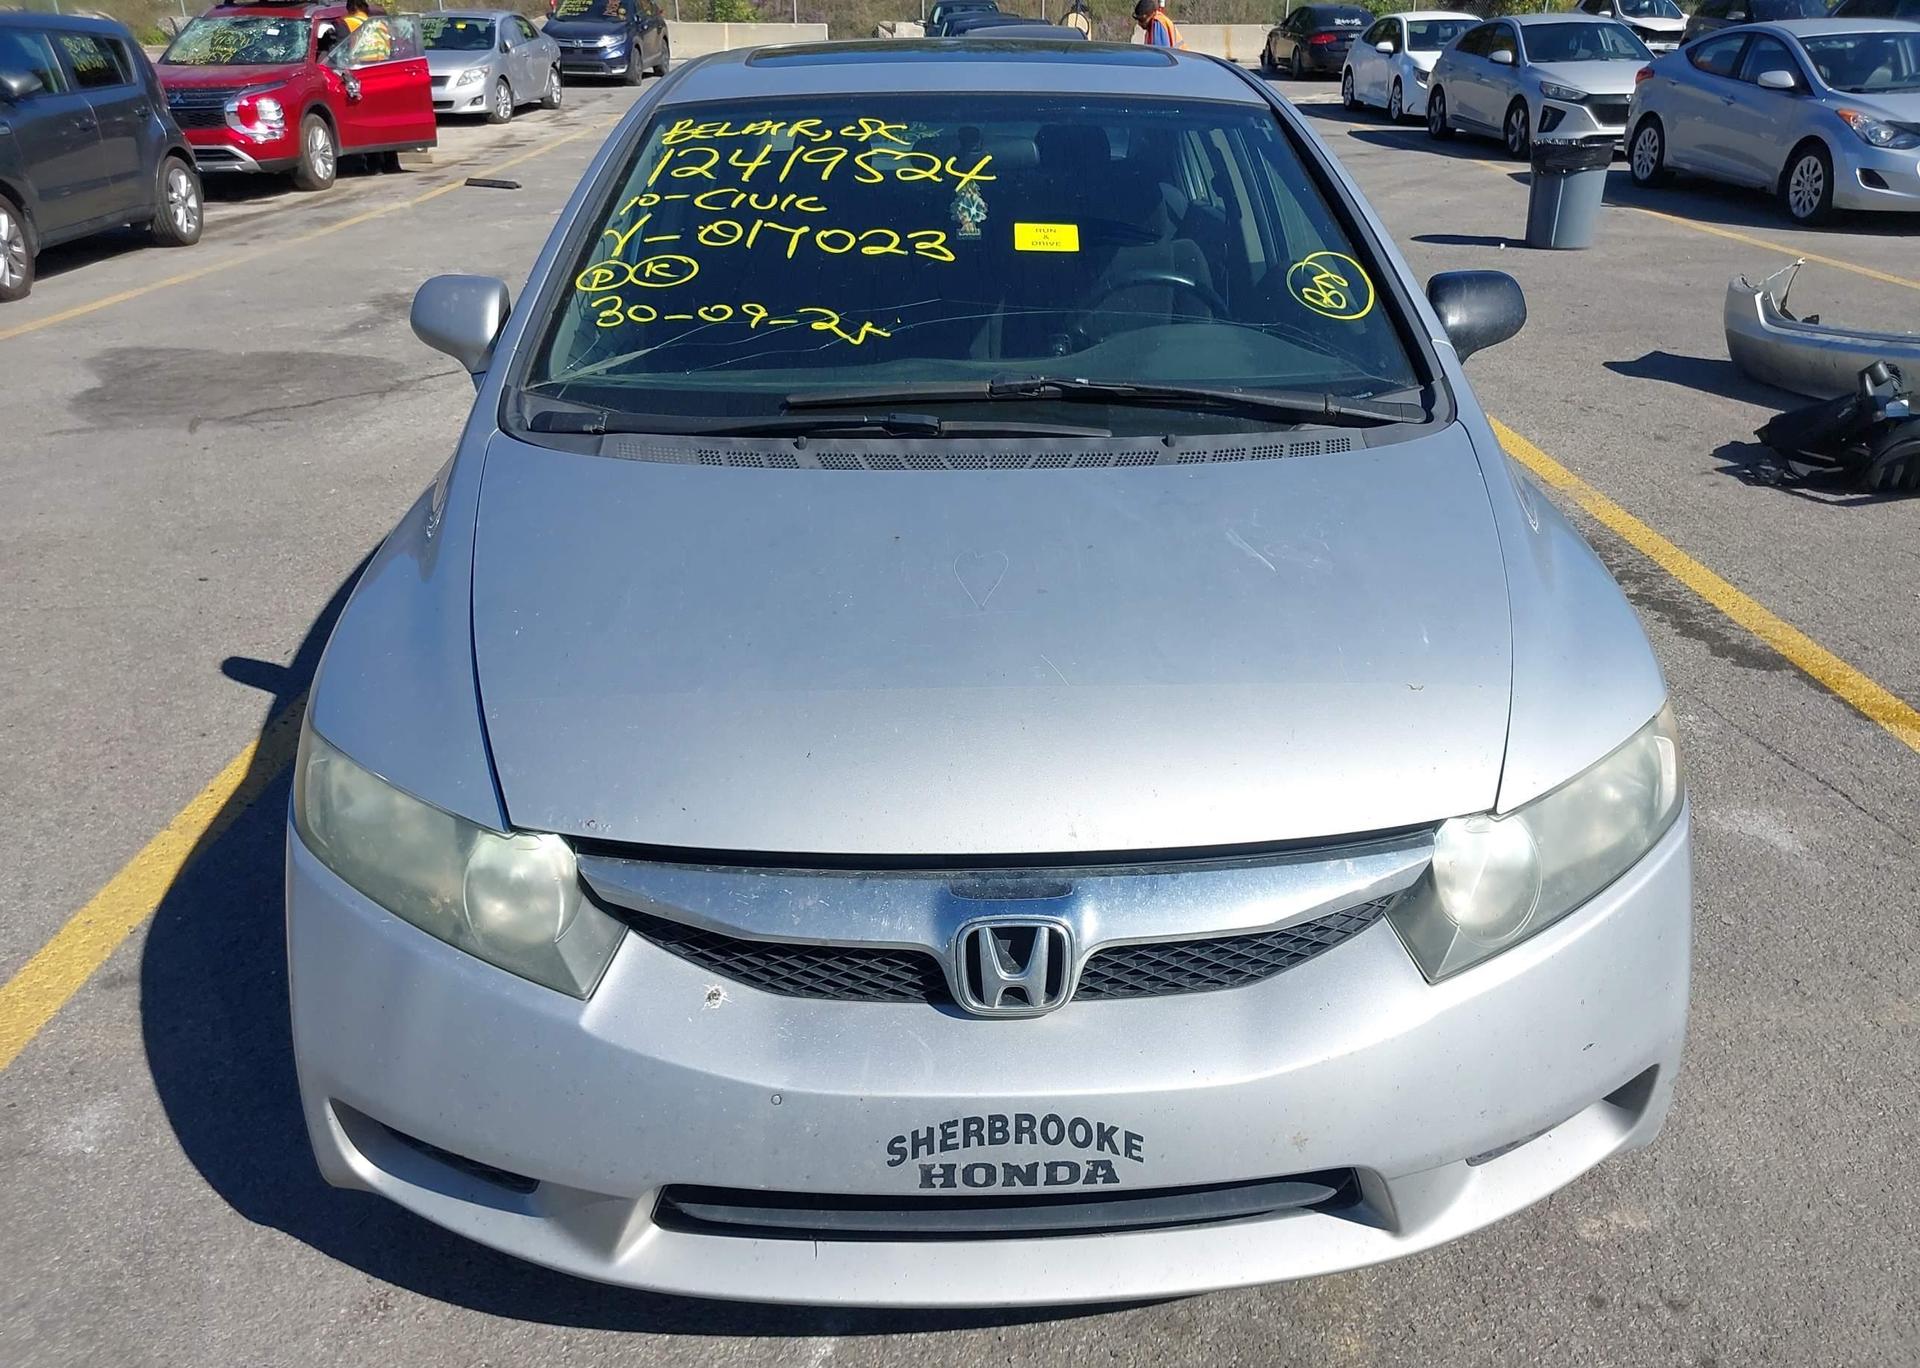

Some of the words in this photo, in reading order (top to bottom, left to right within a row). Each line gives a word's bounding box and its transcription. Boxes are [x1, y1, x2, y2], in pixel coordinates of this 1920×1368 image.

[646, 144, 998, 192] 12419524
[886, 1113, 1145, 1168] SHERBROOKE
[918, 1159, 1120, 1189] HONDA
